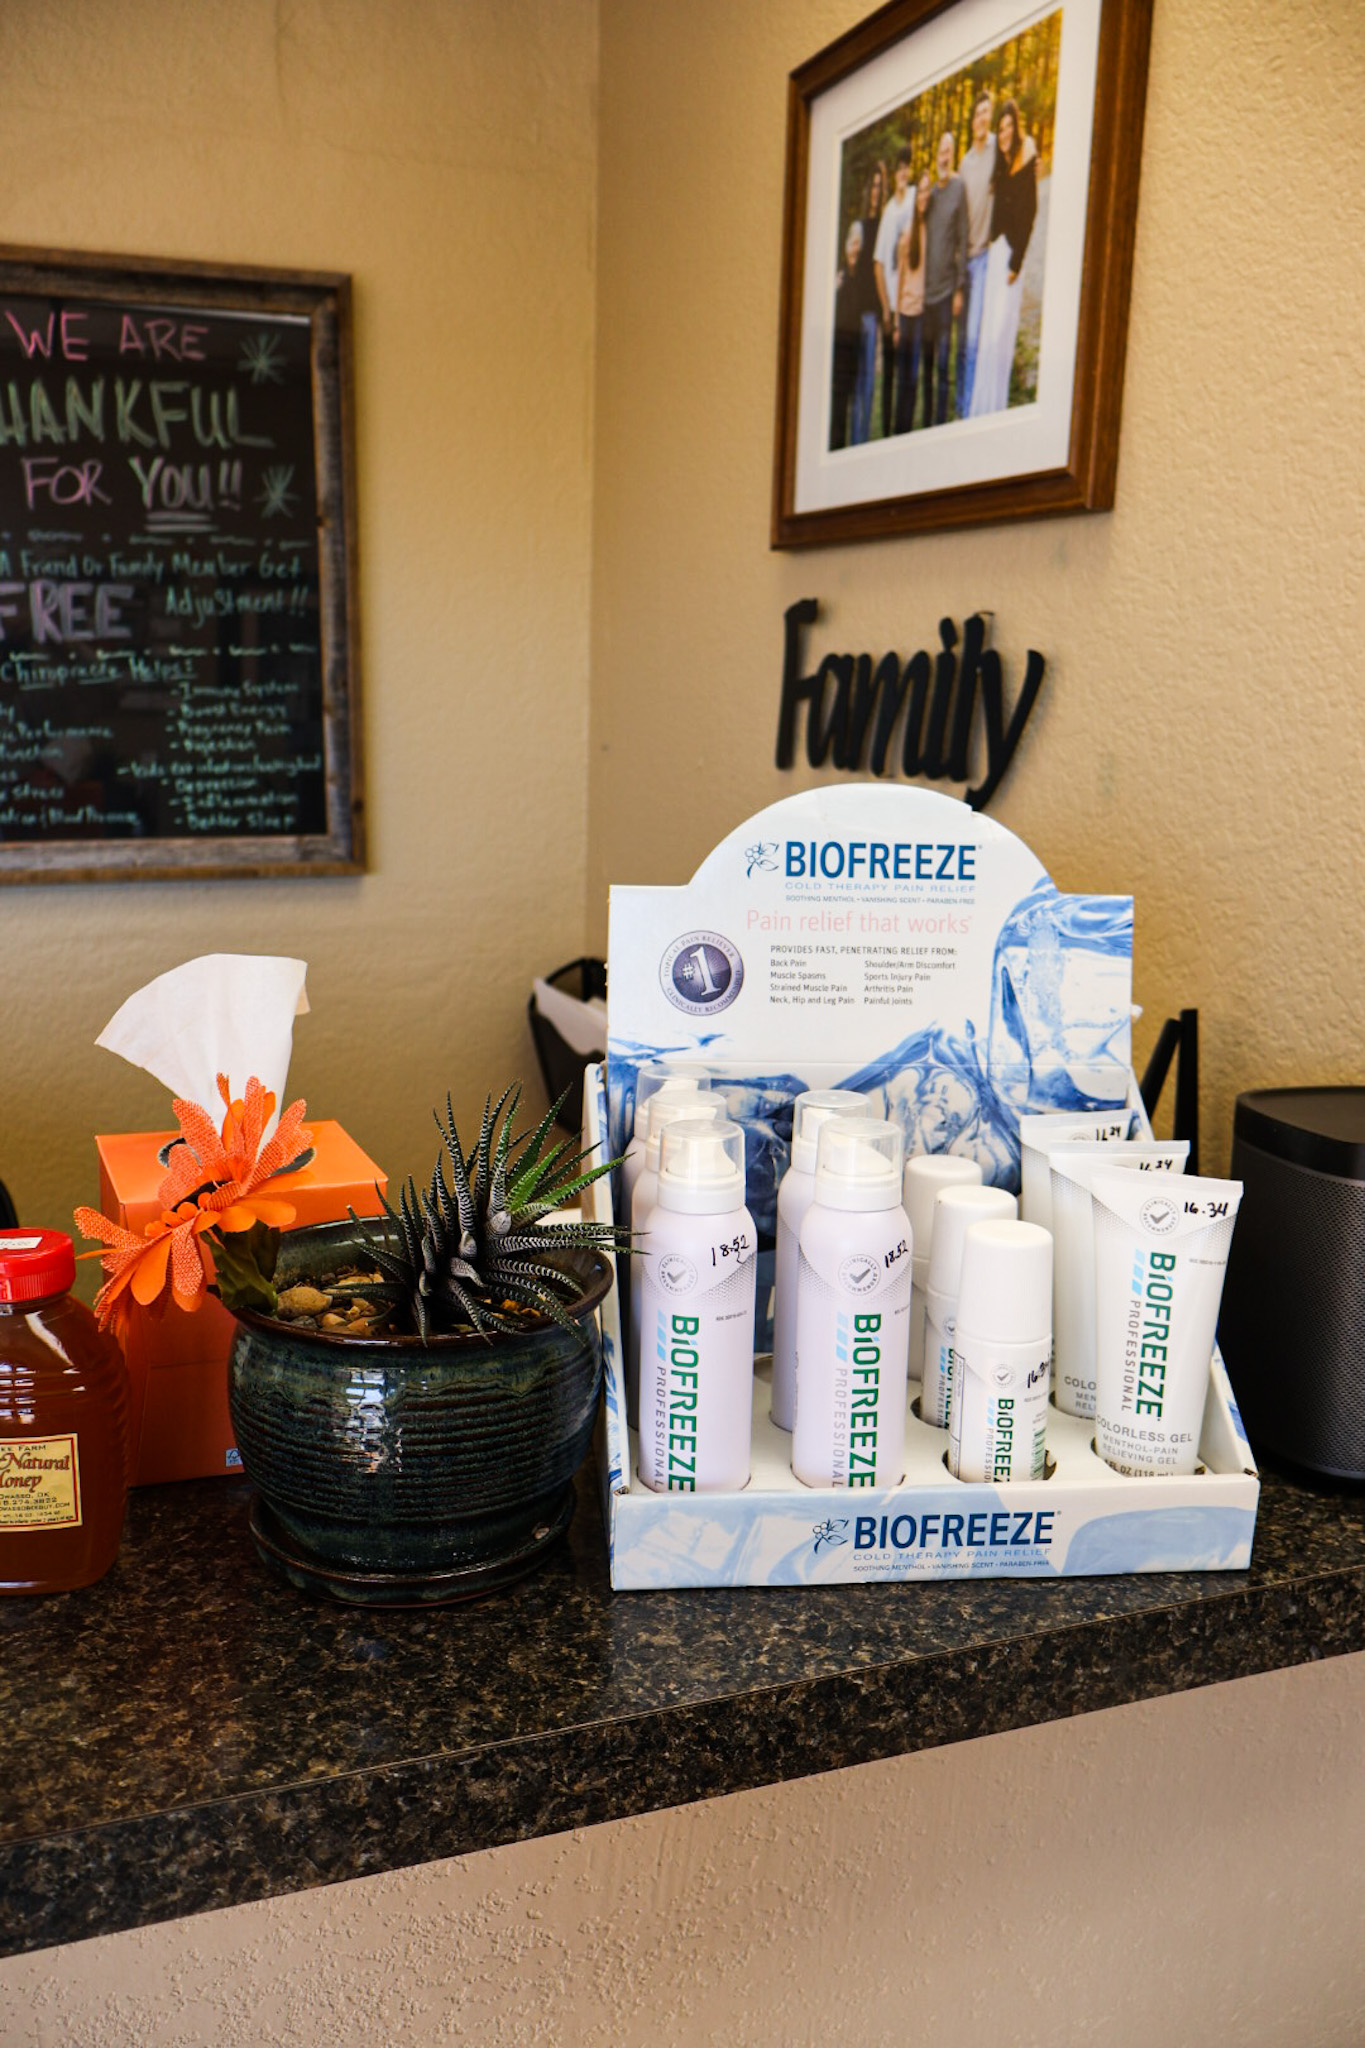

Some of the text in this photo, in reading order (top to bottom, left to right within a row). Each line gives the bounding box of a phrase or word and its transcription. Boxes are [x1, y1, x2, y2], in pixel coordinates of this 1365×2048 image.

[5, 310, 209, 361] WE ARE
[21, 456, 112, 510] FOR
[21, 551, 78, 577] Friend
[171, 553, 251, 578] Member
[259, 553, 301, 579] Get
[0, 579, 135, 644] FREE
[775, 598, 1045, 812] Family
[785, 841, 976, 881] BIOFREEZE
[785, 881, 976, 893] COLD THERAPY PAIN RELIEF
[785, 894, 821, 903] SOOTHING
[823, 895, 855, 903] MENTHOL
[861, 896, 897, 904] VANISHING
[746, 910, 971, 934] Pain relief that works
[770, 945, 958, 956] PROVIDES FAST, PENETRATING RELIEF FROM:
[770, 959, 807, 967] Back Pain
[864, 960, 956, 969] Shoulder/Arm Discomfort
[770, 971, 826, 982] Muscle Spasms
[864, 973, 931, 983] Sports Injury Pain
[770, 984, 801, 992] Strained
[803, 984, 829, 992] Muscle
[864, 985, 914, 993] Arthritis Pain
[769, 996, 790, 1005] Neck,
[792, 996, 805, 1005] Hip
[807, 996, 821, 1004] and
[823, 997, 836, 1005] Leg
[864, 997, 890, 1005] Painful
[1184, 1201, 1229, 1218] 16.34
[1121, 1300, 1141, 1412] PROFESSIONAL
[653, 1366, 667, 1487] PROFESSIONAL
[832, 1368, 848, 1487] PROFESSIONAL
[1102, 1433, 1179, 1455] MENTHOL-PAIN
[1170, 1433, 1193, 1444] GEL
[0, 1452, 70, 1471] Natural
[1101, 1443, 1178, 1465] RELIEVING GEL
[854, 1511, 1055, 1550] BIOFREEZE
[853, 1548, 1051, 1561] COLD THERAPY PAIN RELIEF
[854, 1564, 890, 1572] SOOTHING
[892, 1563, 925, 1571] MENTHOL
[932, 1562, 969, 1570] VANISHING
